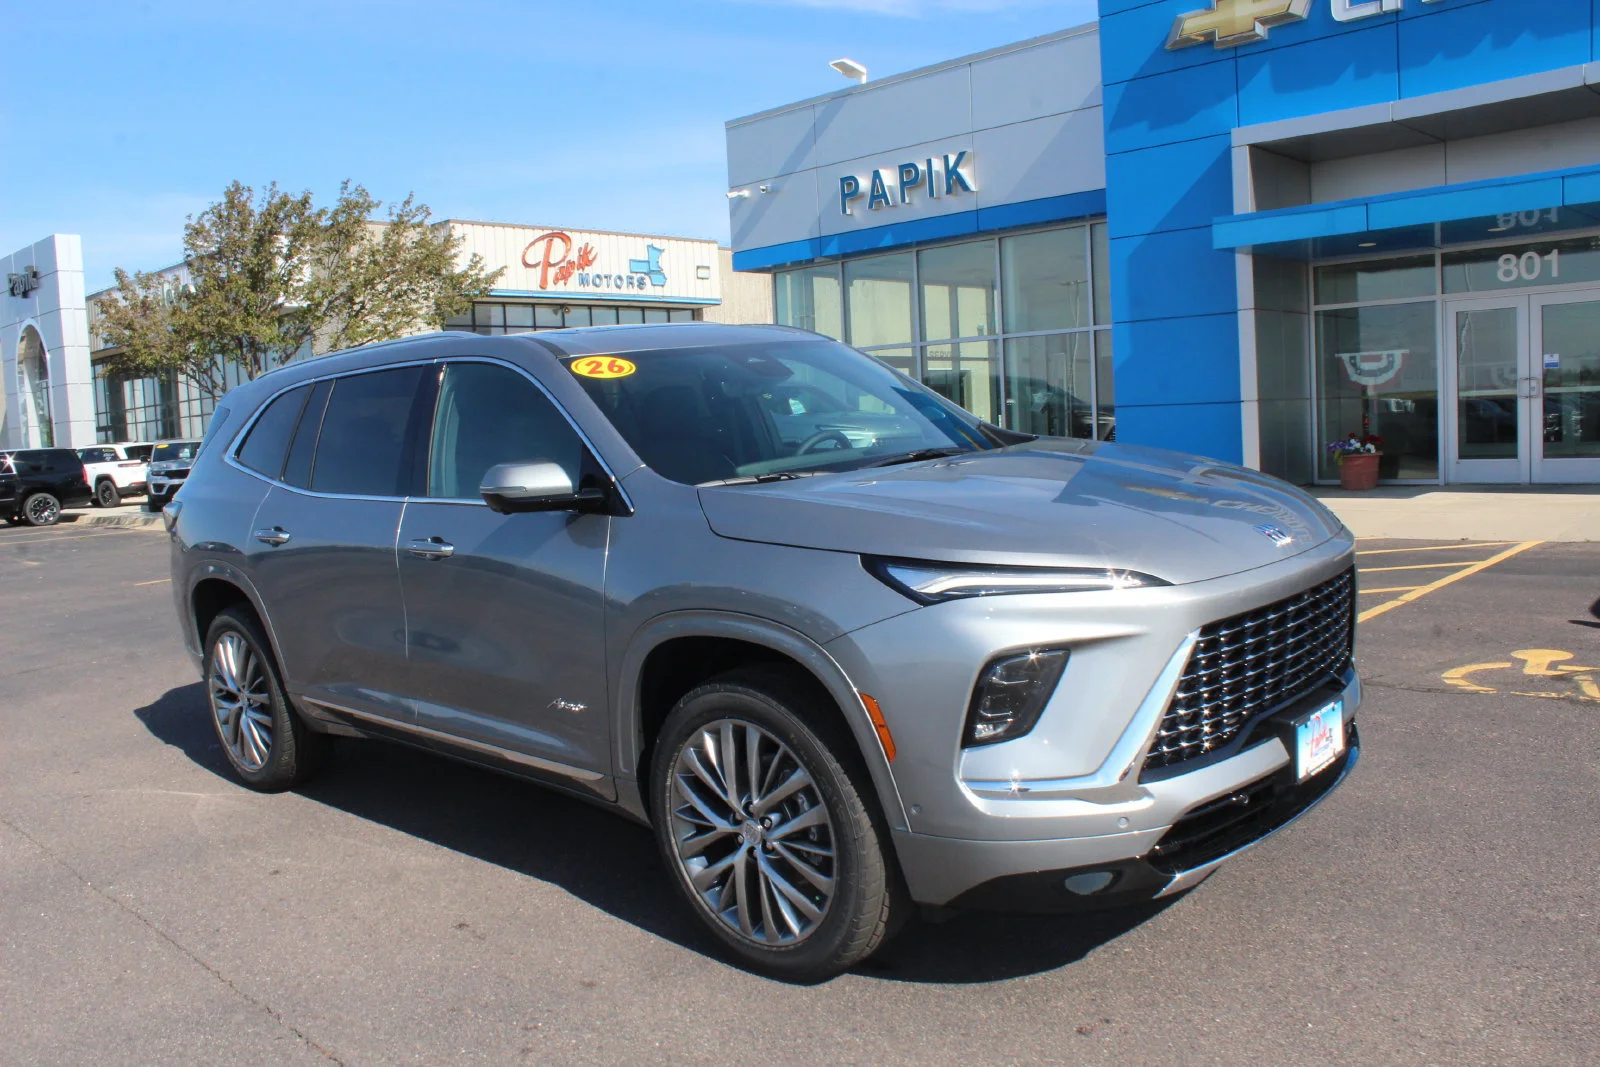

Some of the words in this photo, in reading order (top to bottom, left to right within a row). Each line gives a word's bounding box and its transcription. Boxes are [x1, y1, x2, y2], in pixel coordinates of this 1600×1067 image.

[839, 150, 975, 215] PAPIK
[521, 231, 599, 289] Papik
[1497, 249, 1559, 282] 801
[578, 272, 647, 290] MOTORS
[584, 359, 626, 375] 26
